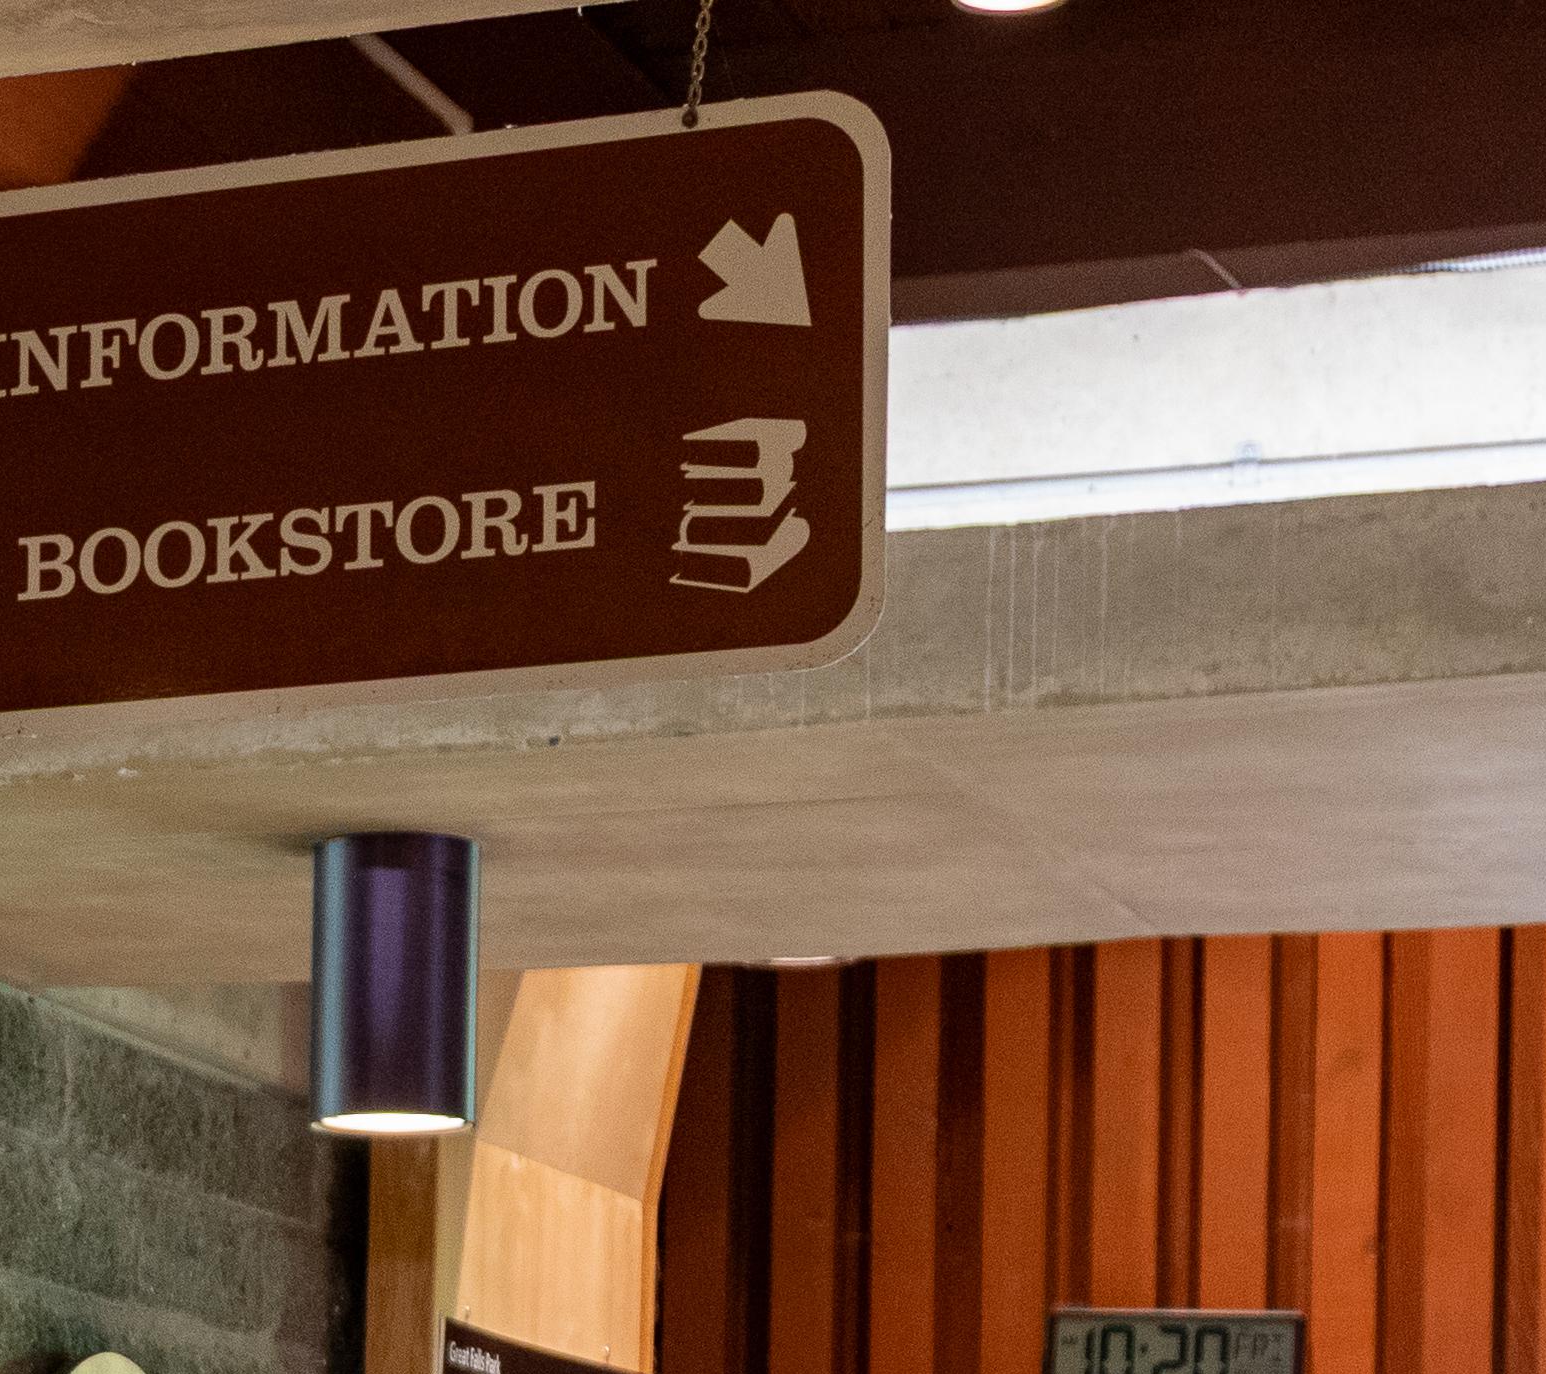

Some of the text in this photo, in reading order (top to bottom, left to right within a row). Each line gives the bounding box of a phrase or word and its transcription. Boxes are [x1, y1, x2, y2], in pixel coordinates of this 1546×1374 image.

[17, 482, 597, 602] BOOKSTORE
[448, 1341, 469, 1369] Great
[470, 1347, 485, 1374] Falls
